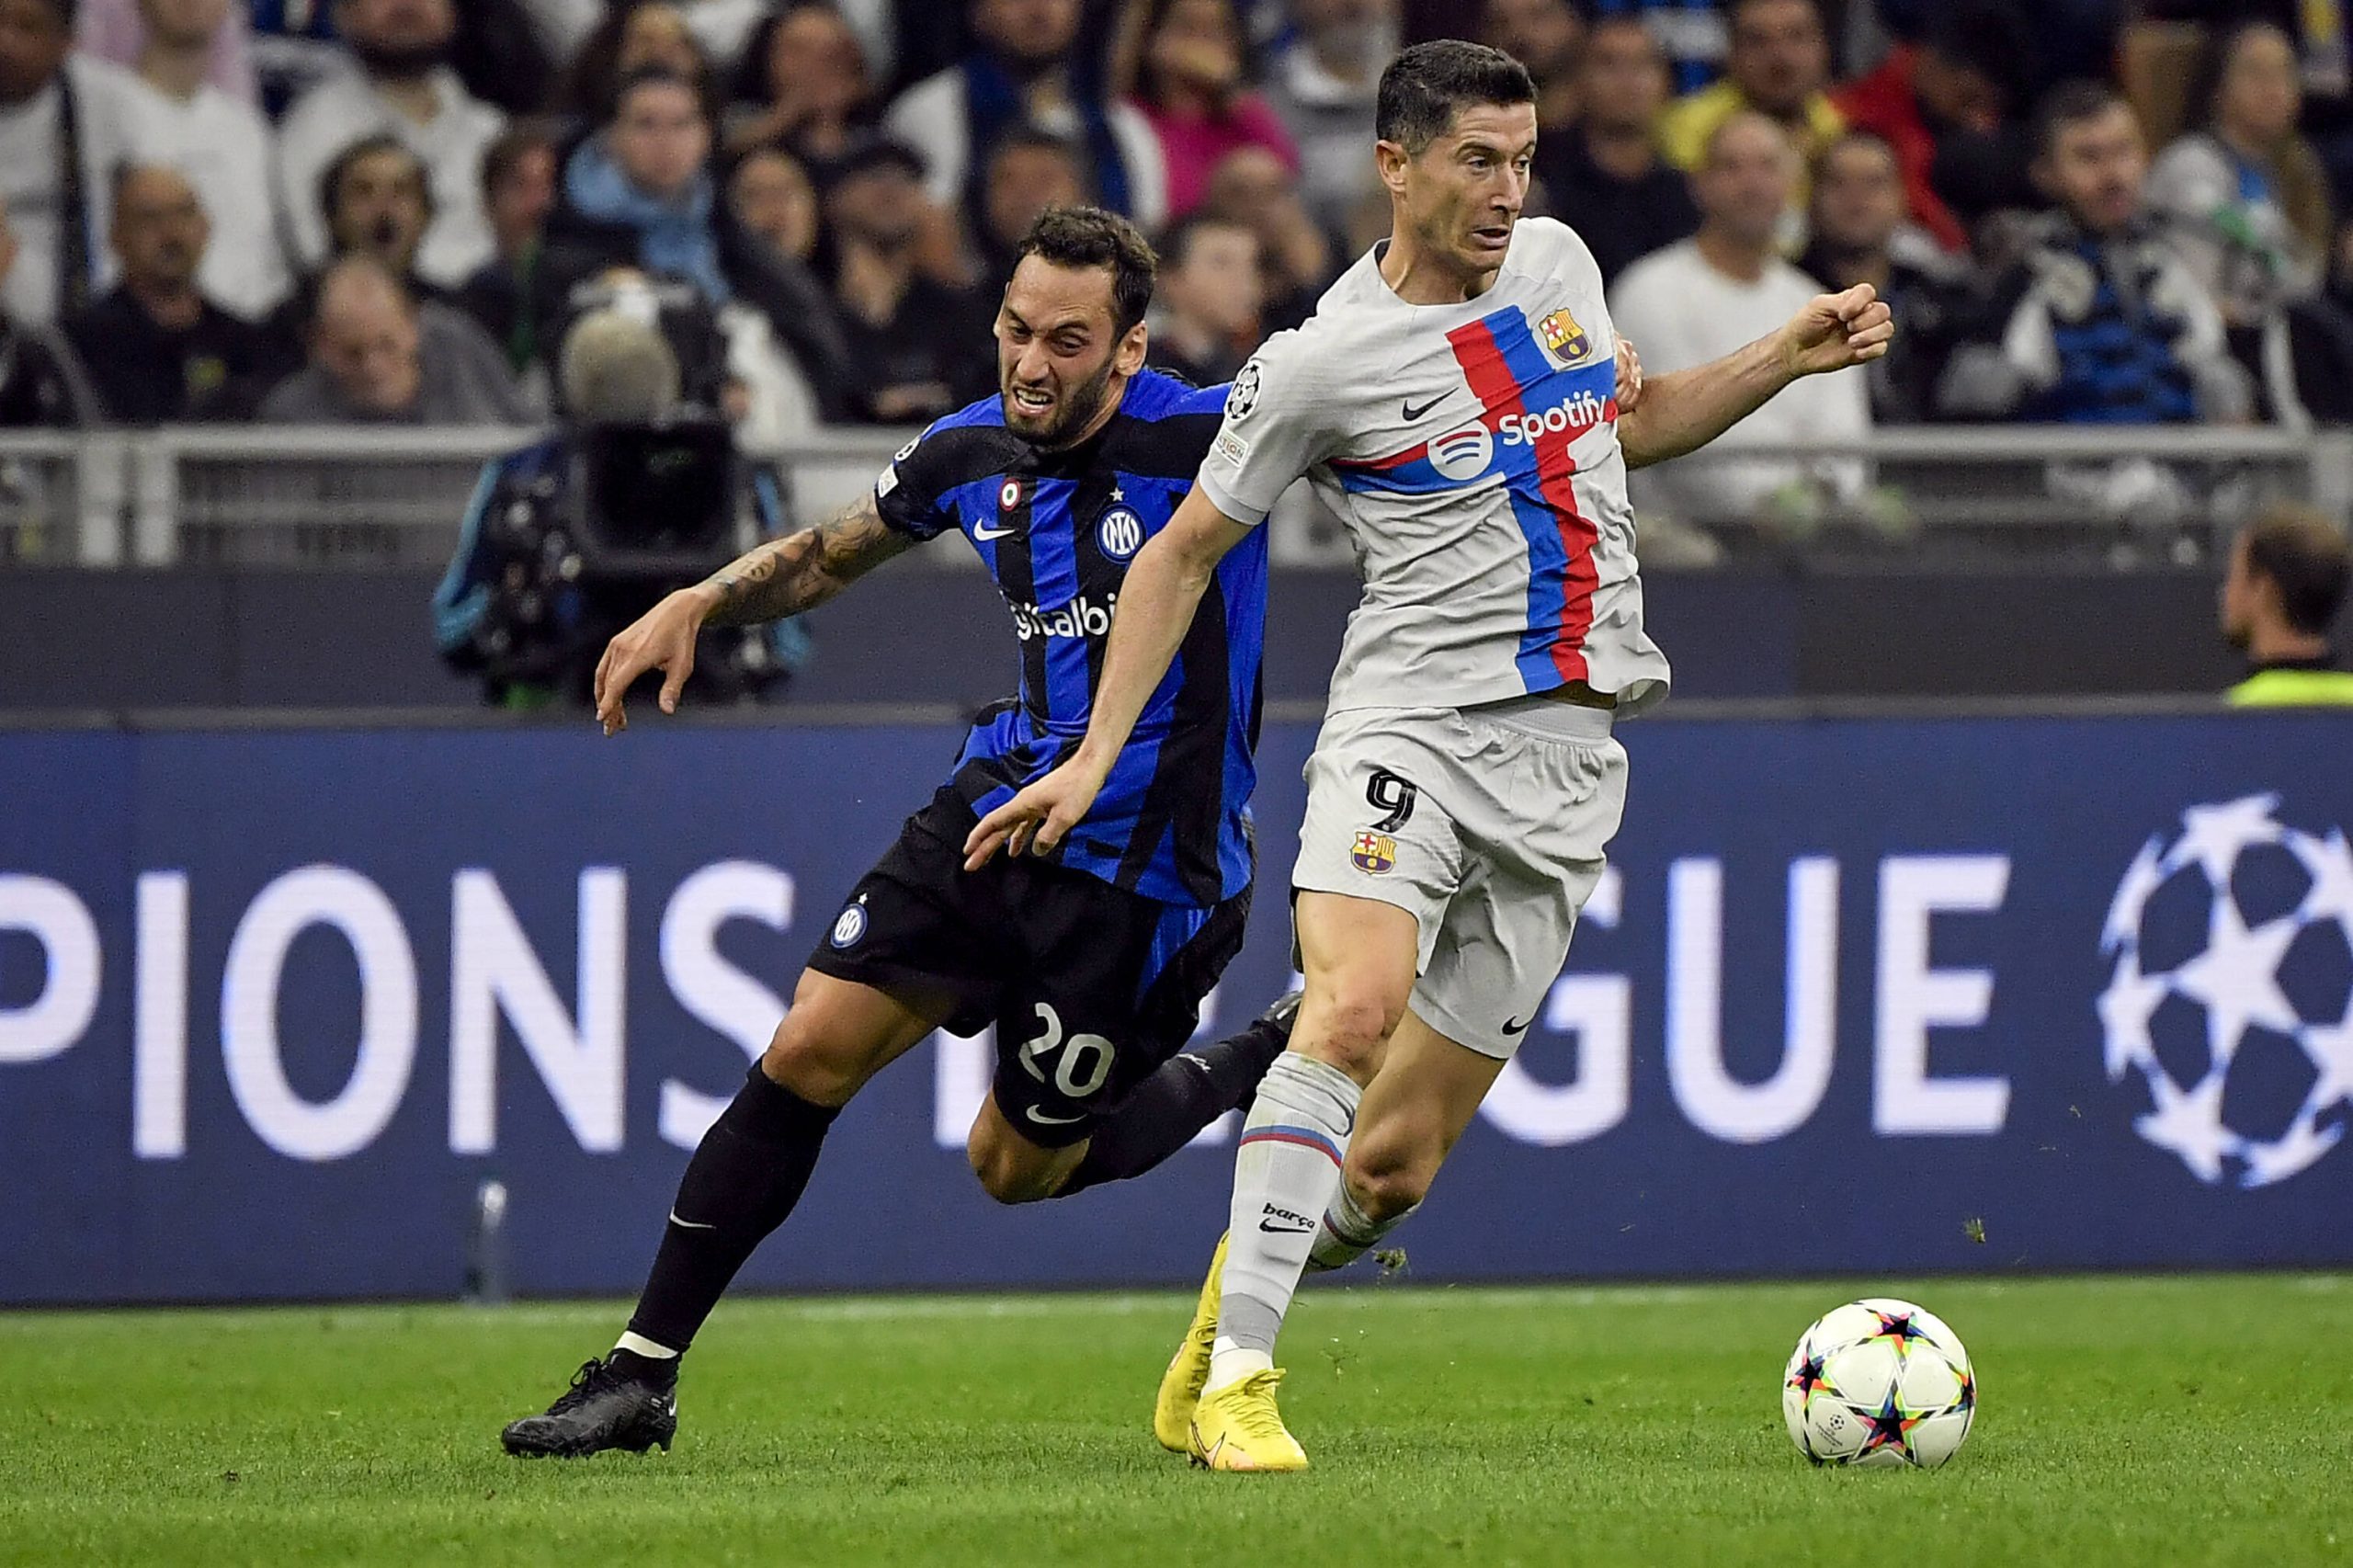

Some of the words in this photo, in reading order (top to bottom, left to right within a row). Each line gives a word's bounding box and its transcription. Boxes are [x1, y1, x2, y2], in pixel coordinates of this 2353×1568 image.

[1498, 390, 1607, 446] Spotify
[1366, 770, 1417, 833] 9
[1017, 1002, 1115, 1097] 20
